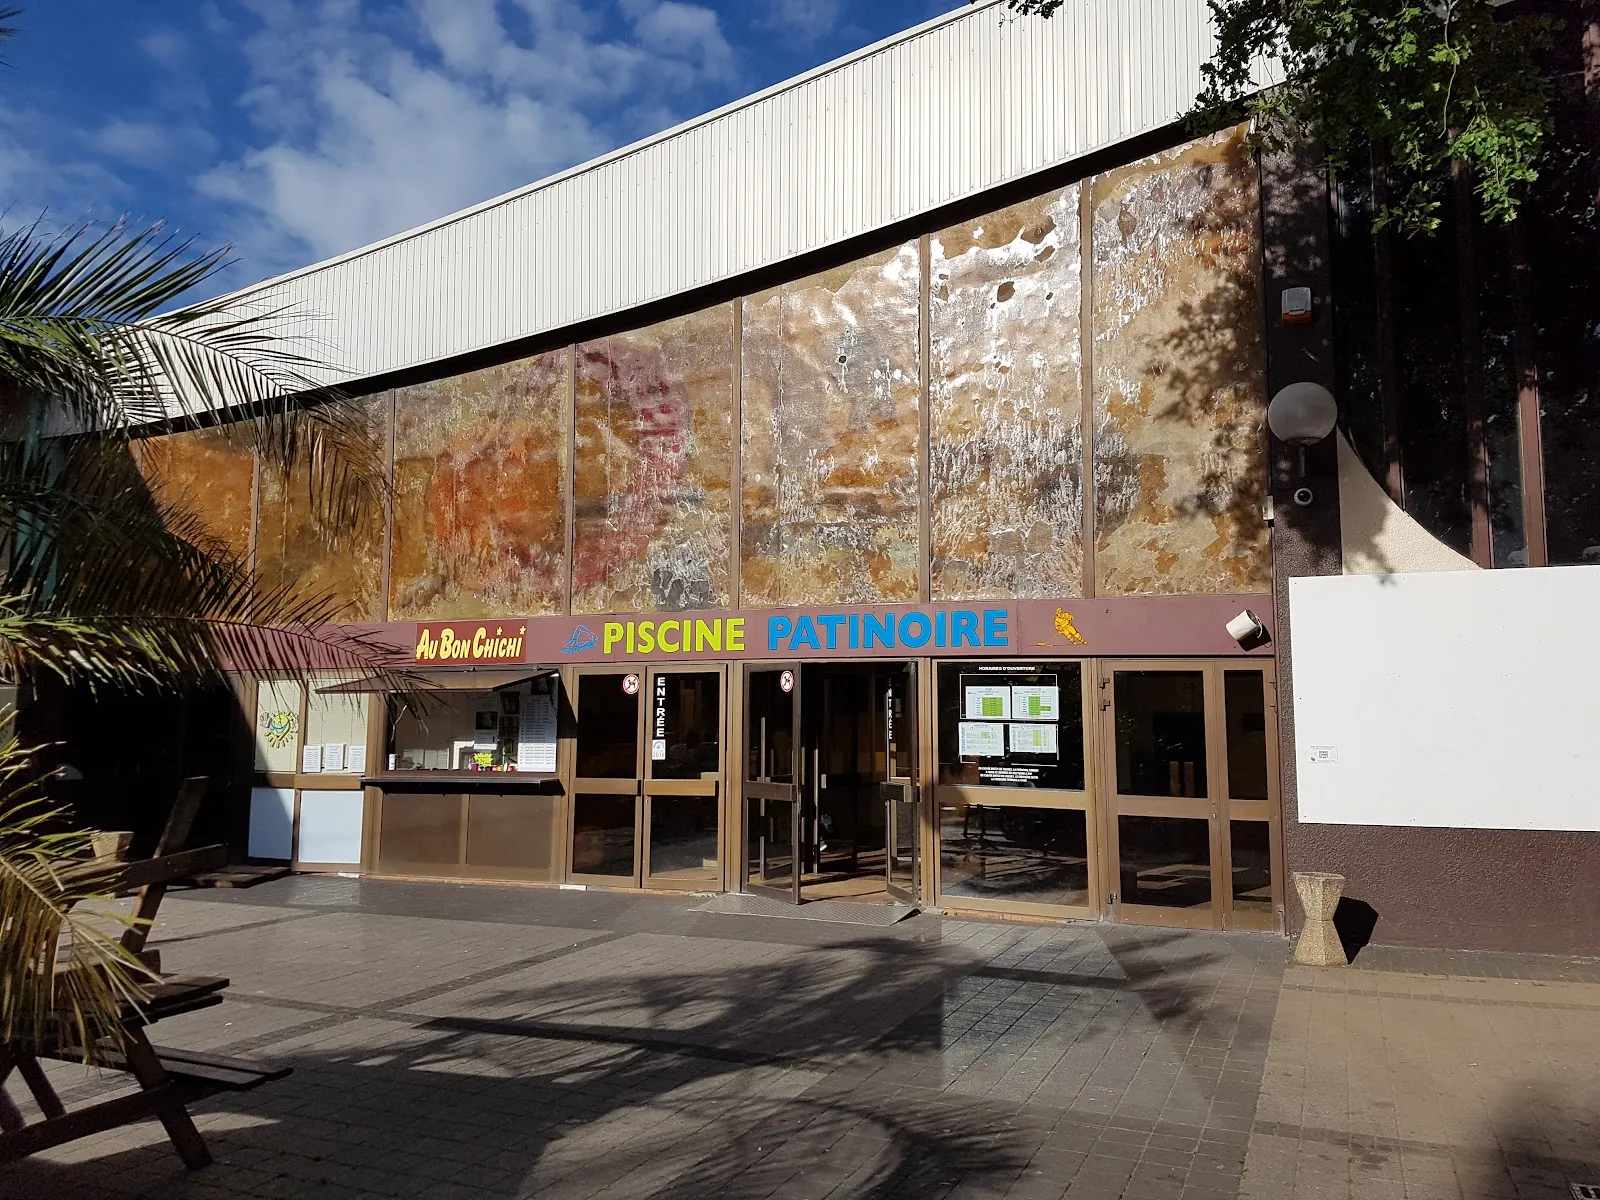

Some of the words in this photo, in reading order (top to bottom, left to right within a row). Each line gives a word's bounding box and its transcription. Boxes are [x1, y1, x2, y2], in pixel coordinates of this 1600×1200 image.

[603, 617, 745, 654] PISCINE
[767, 609, 1008, 650] PATINOIRE
[656, 676, 666, 738] ENTRÉE
